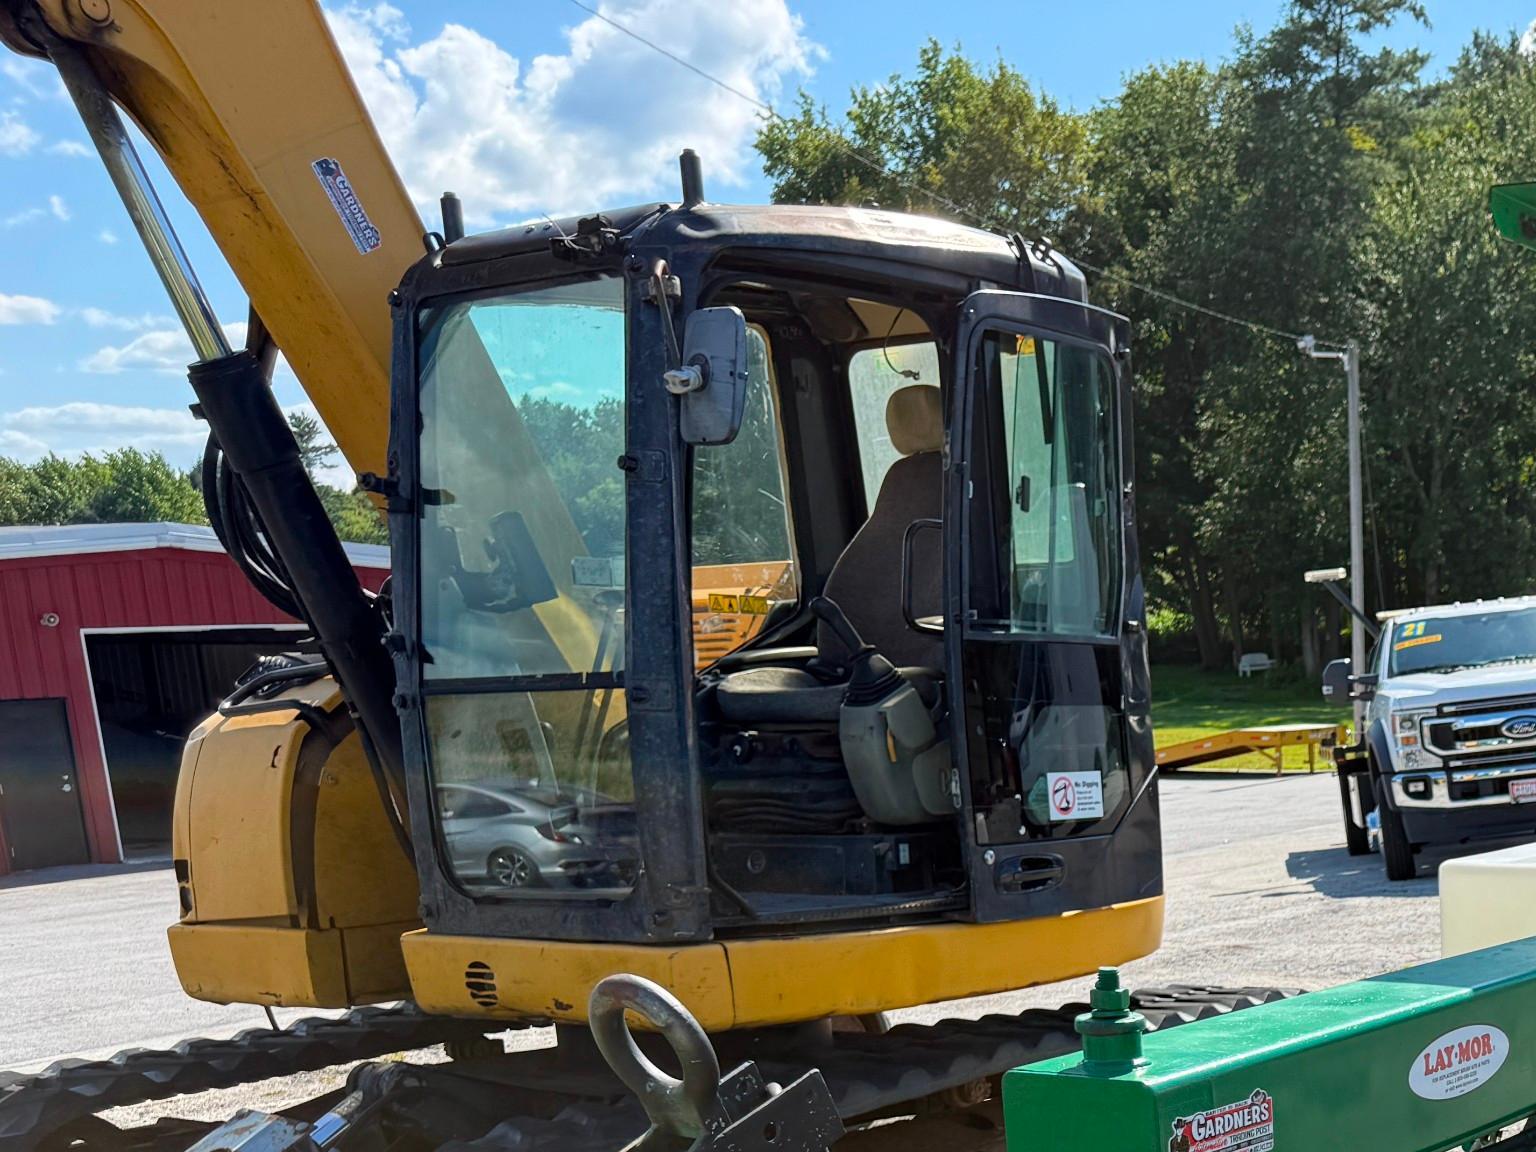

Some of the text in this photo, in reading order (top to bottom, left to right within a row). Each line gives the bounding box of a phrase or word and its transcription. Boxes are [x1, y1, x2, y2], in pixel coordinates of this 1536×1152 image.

[335, 175, 377, 246] GARDNERS
[1512, 722, 1536, 734] Ford
[1191, 1103, 1270, 1142] GARDNERS
[1256, 1124, 1271, 1137] POST
